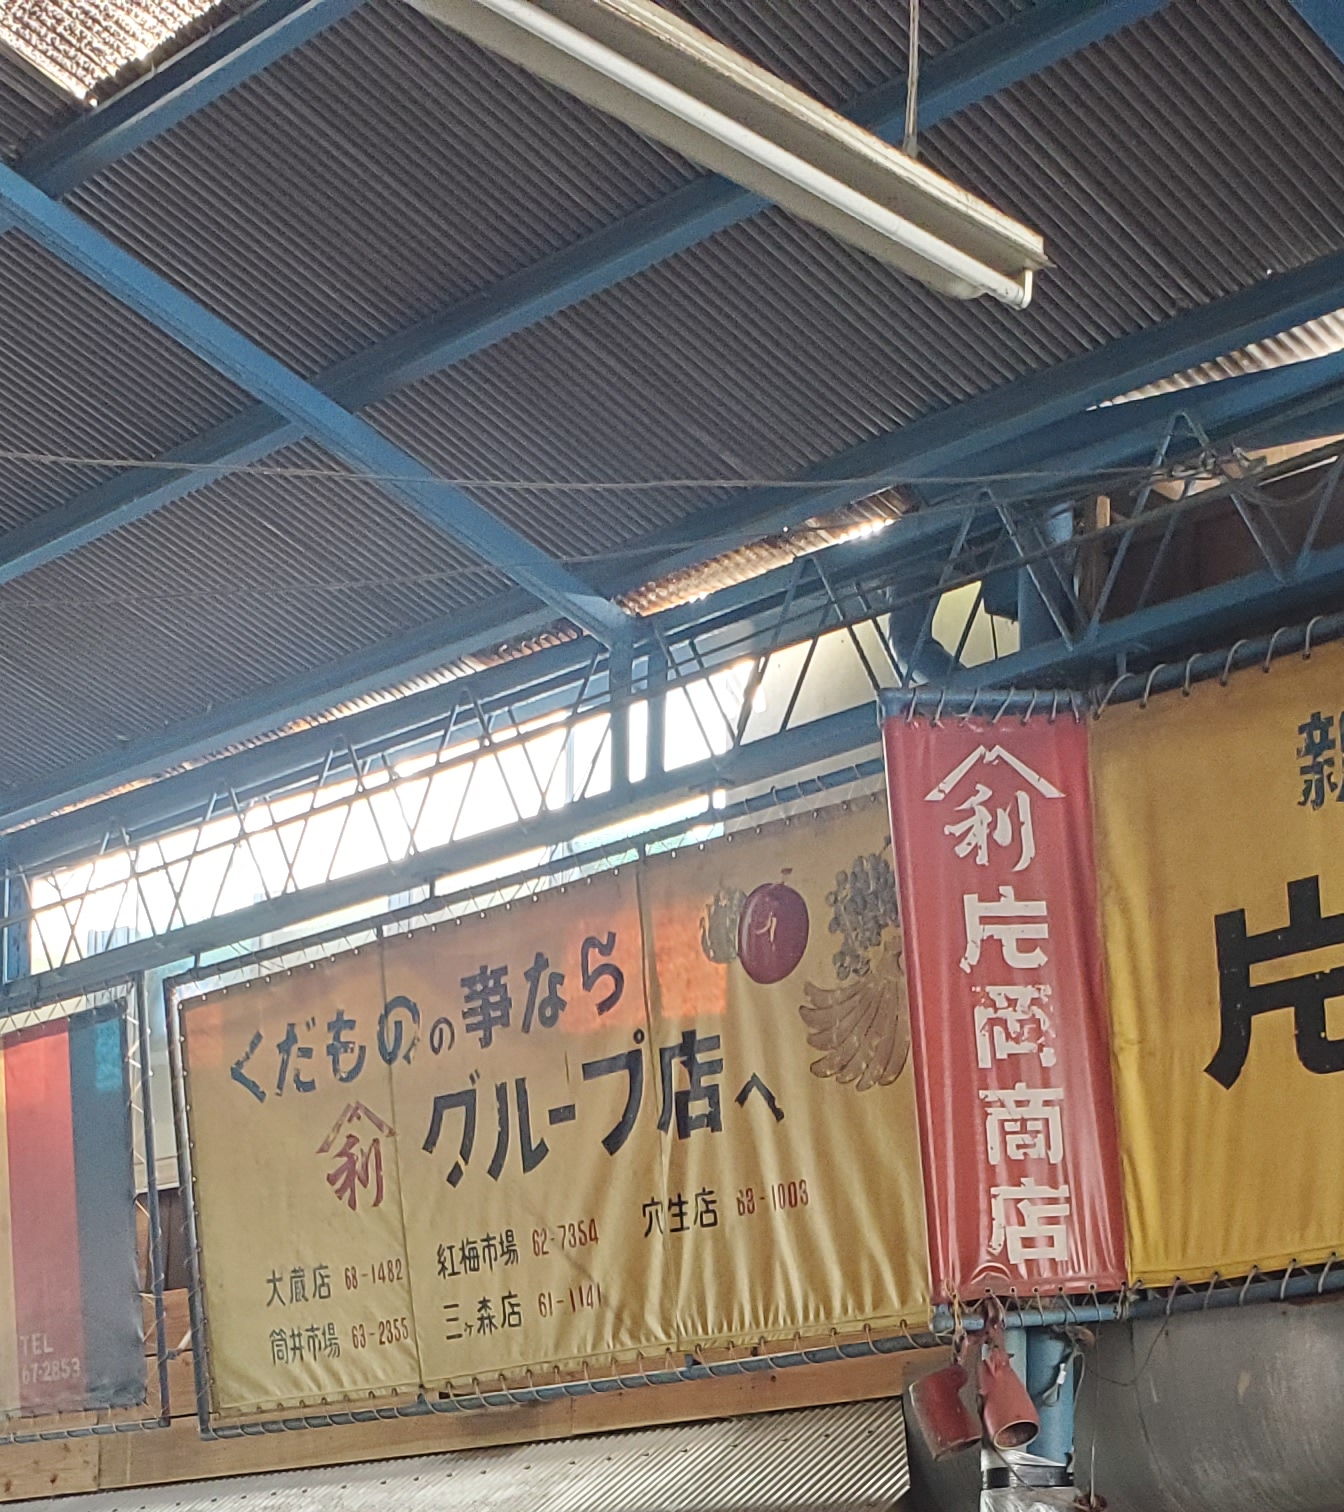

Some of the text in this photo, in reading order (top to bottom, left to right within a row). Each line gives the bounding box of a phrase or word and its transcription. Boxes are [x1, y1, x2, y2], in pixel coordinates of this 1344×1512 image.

[421, 1027, 785, 1189] グループ店へ
[641, 1186, 719, 1239] 穴生店
[436, 1217, 600, 1280] 紅梅市場 62-7354
[265, 1257, 404, 1308] 大蔵店 68-1482
[537, 1282, 602, 1318] 61-1141
[18, 1332, 55, 1356] TEL
[268, 1316, 409, 1366] 筒井市場 63-2355
